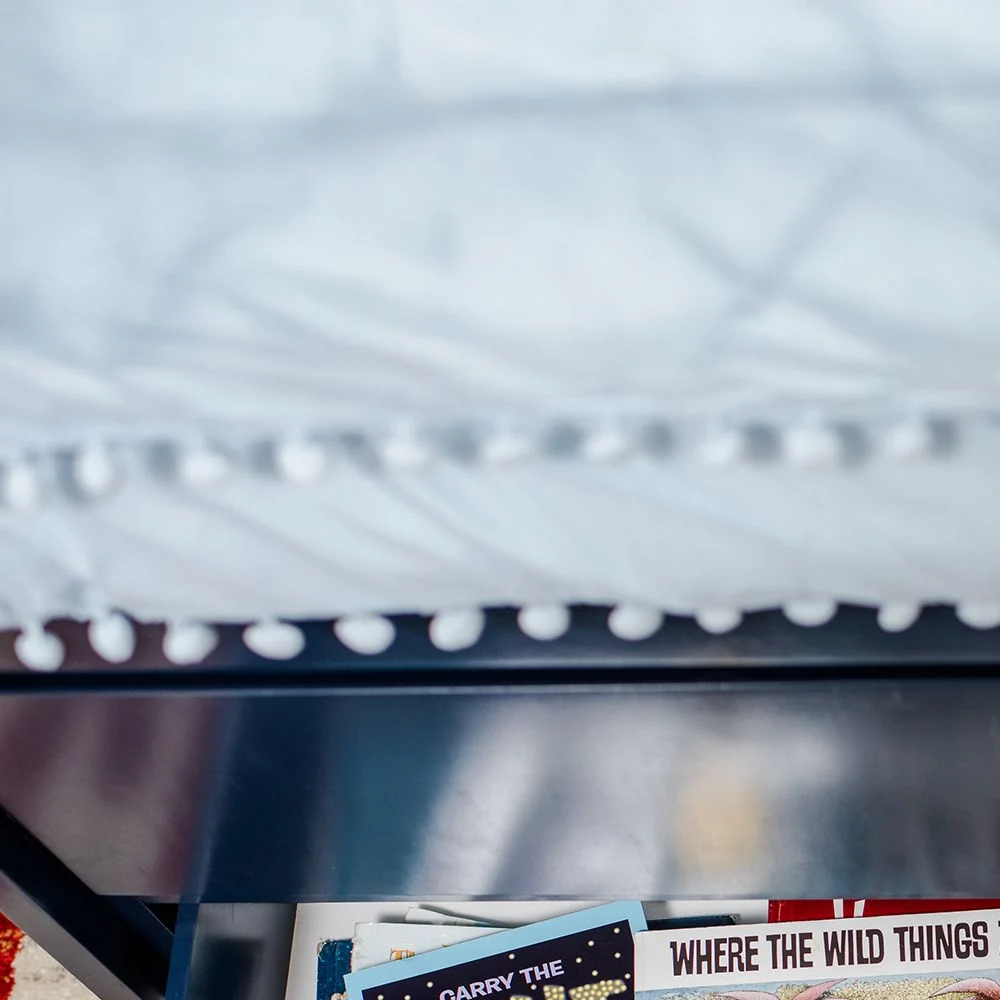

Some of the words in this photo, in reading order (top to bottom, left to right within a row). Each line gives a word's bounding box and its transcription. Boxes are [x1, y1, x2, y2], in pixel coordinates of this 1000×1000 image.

[670, 935, 759, 976] WHERE
[766, 932, 813, 970] THE
[823, 929, 885, 967] WILD
[893, 921, 989, 962] THINGS
[518, 959, 565, 985] THE
